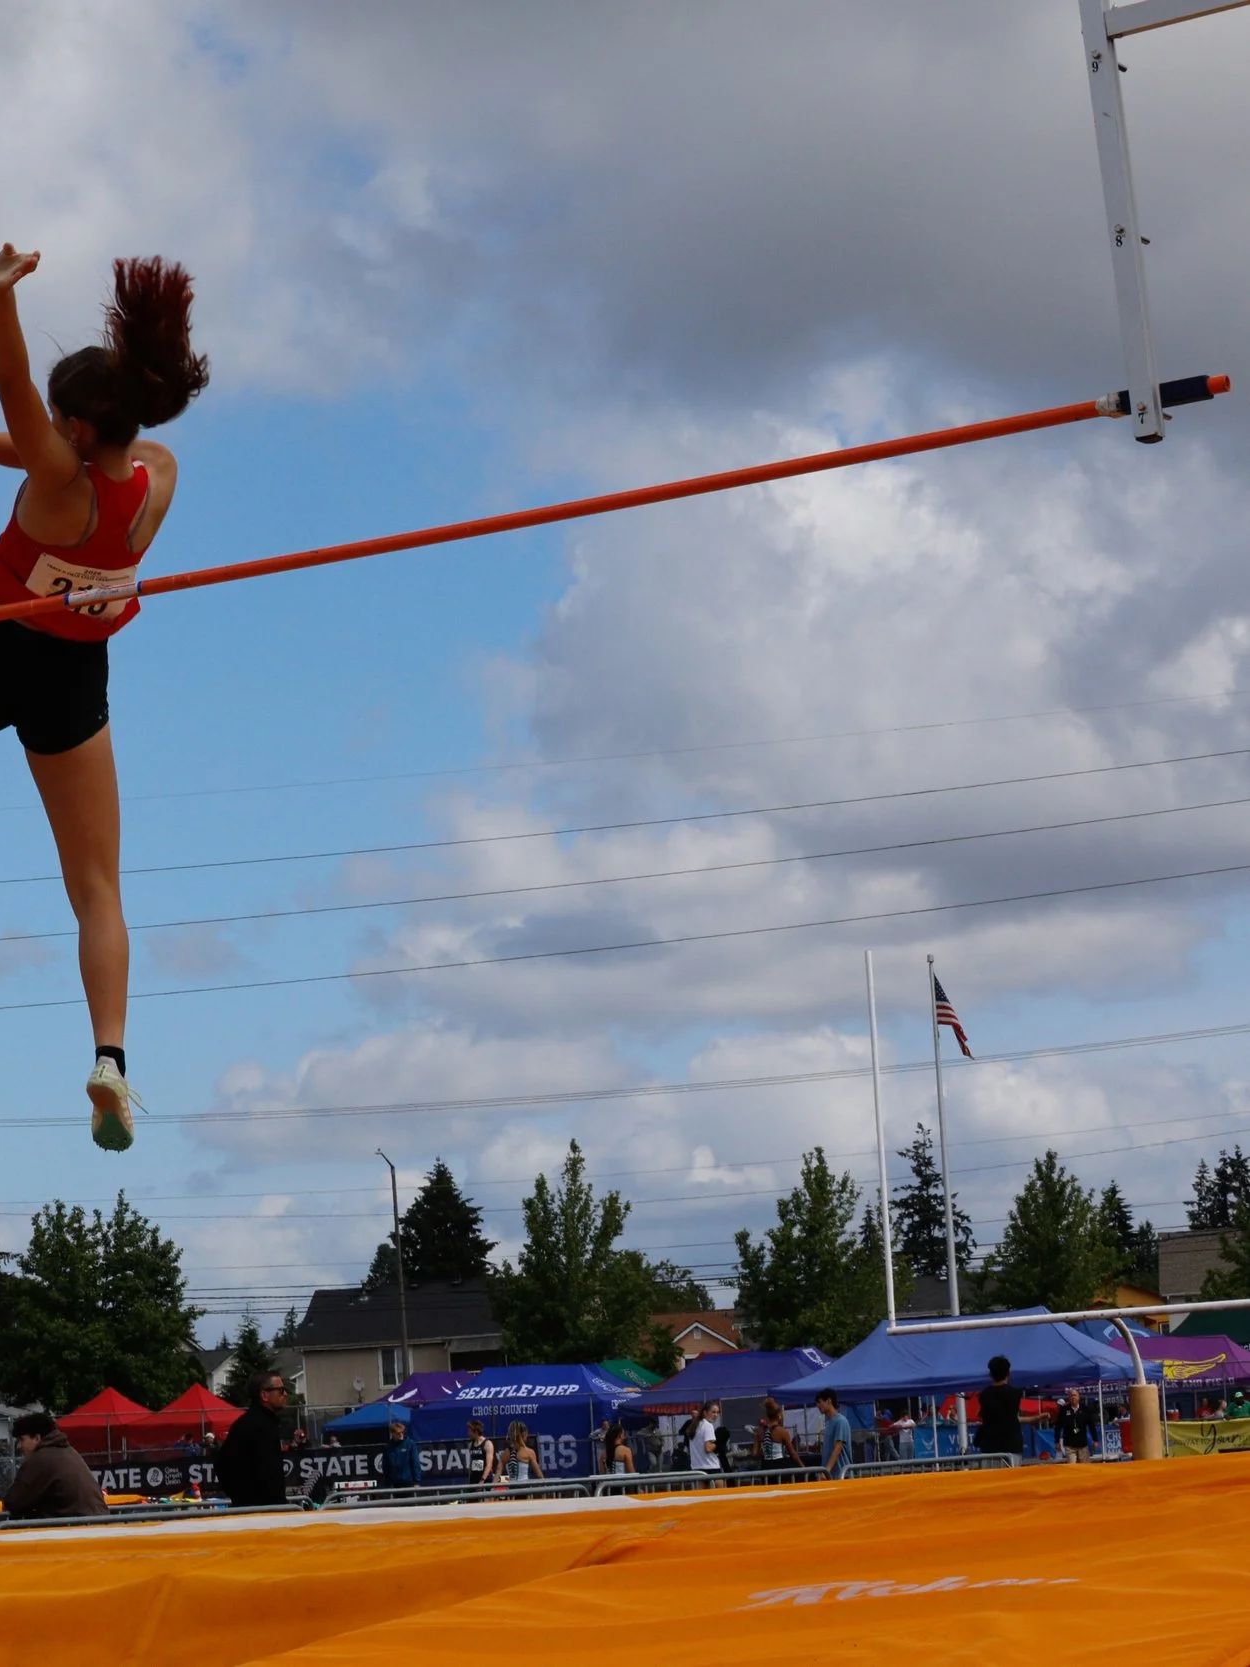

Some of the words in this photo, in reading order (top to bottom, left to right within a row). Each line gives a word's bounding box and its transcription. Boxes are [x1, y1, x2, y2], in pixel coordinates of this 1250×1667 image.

[456, 1384, 528, 1401] SEATTLE
[530, 1383, 580, 1397] PREP
[472, 1405, 499, 1417] CROSS
[500, 1403, 539, 1416] COUNTRY
[300, 1453, 369, 1478] STATE
[418, 1449, 471, 1472] STAT
[91, 1467, 142, 1490] TATE
